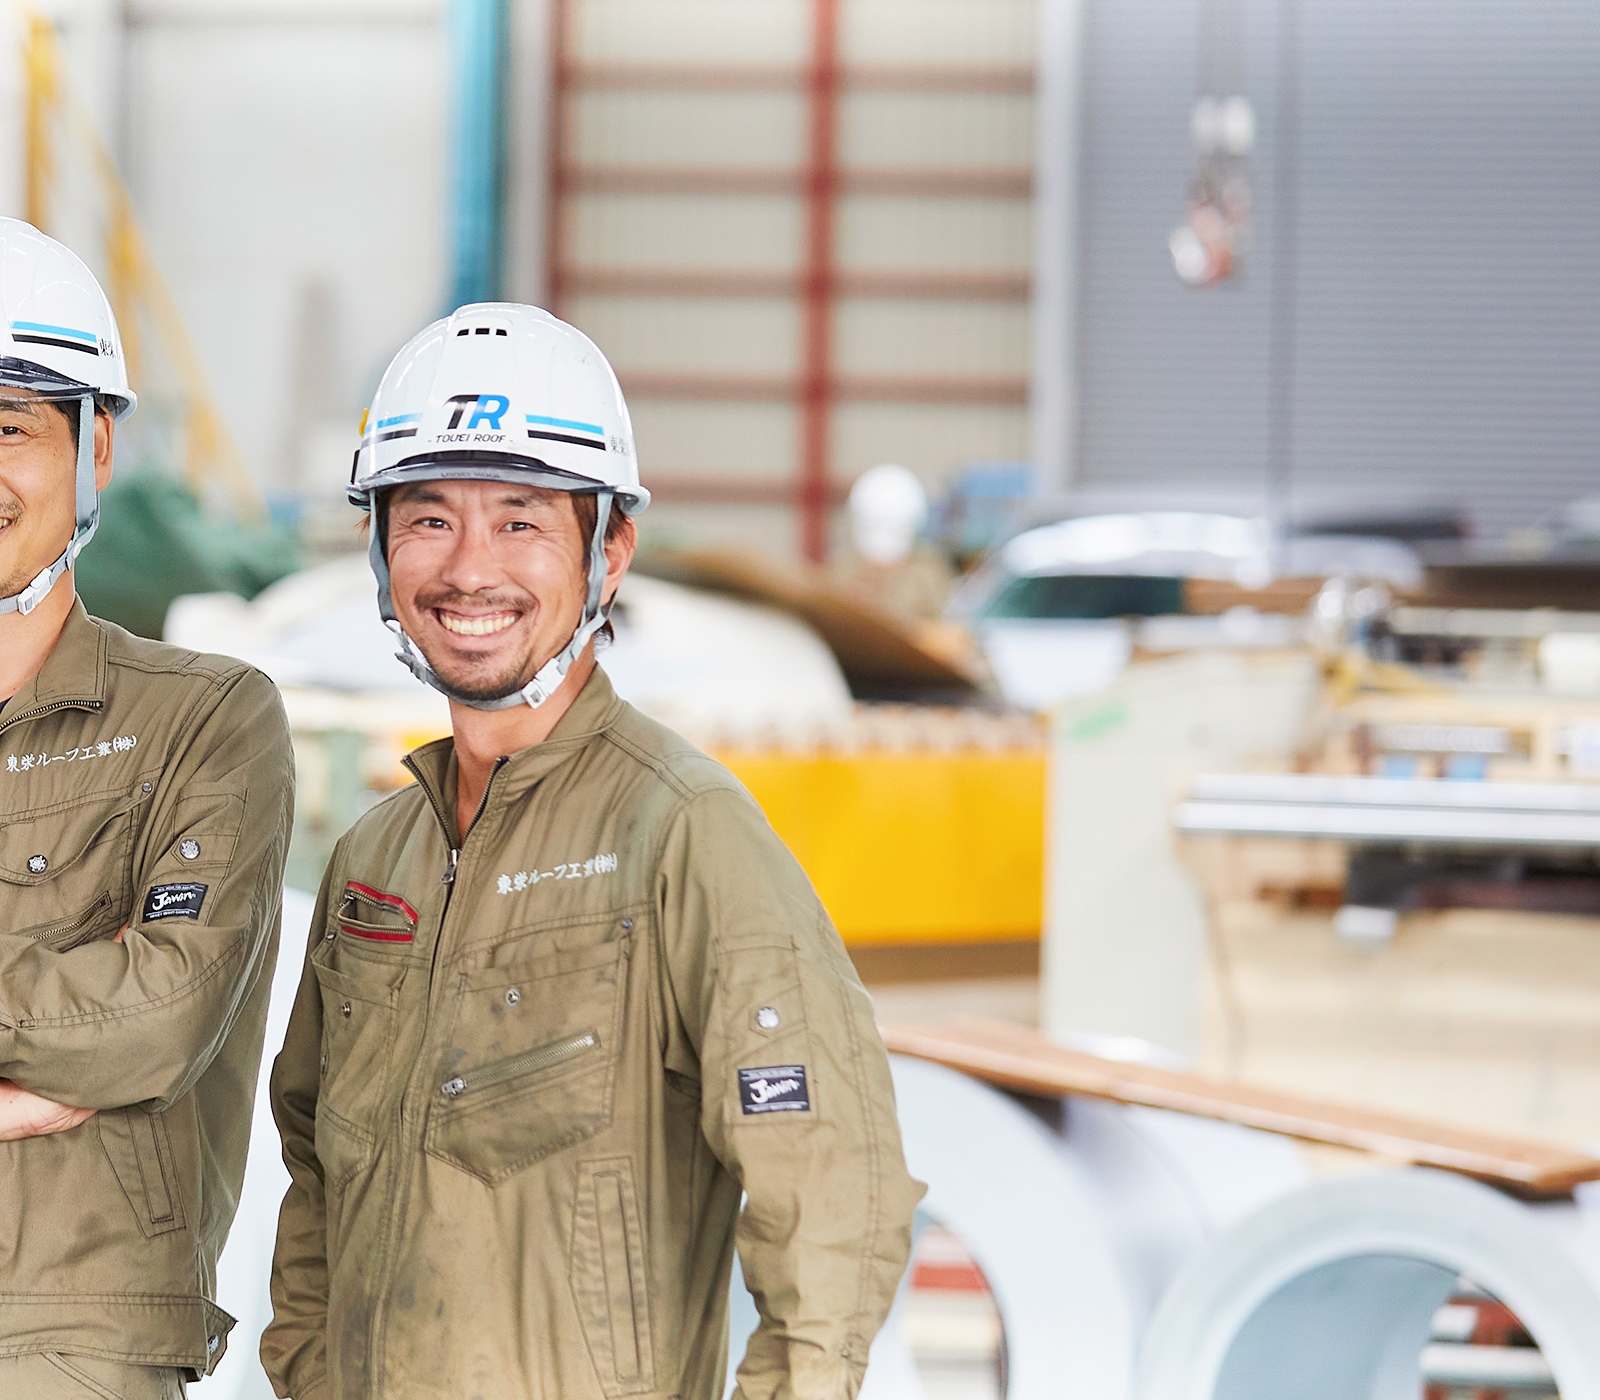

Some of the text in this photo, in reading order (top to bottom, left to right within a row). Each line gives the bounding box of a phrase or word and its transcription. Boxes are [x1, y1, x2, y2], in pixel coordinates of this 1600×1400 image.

[442, 394, 510, 430] TR
[436, 433, 507, 444] TOUEI ROOF
